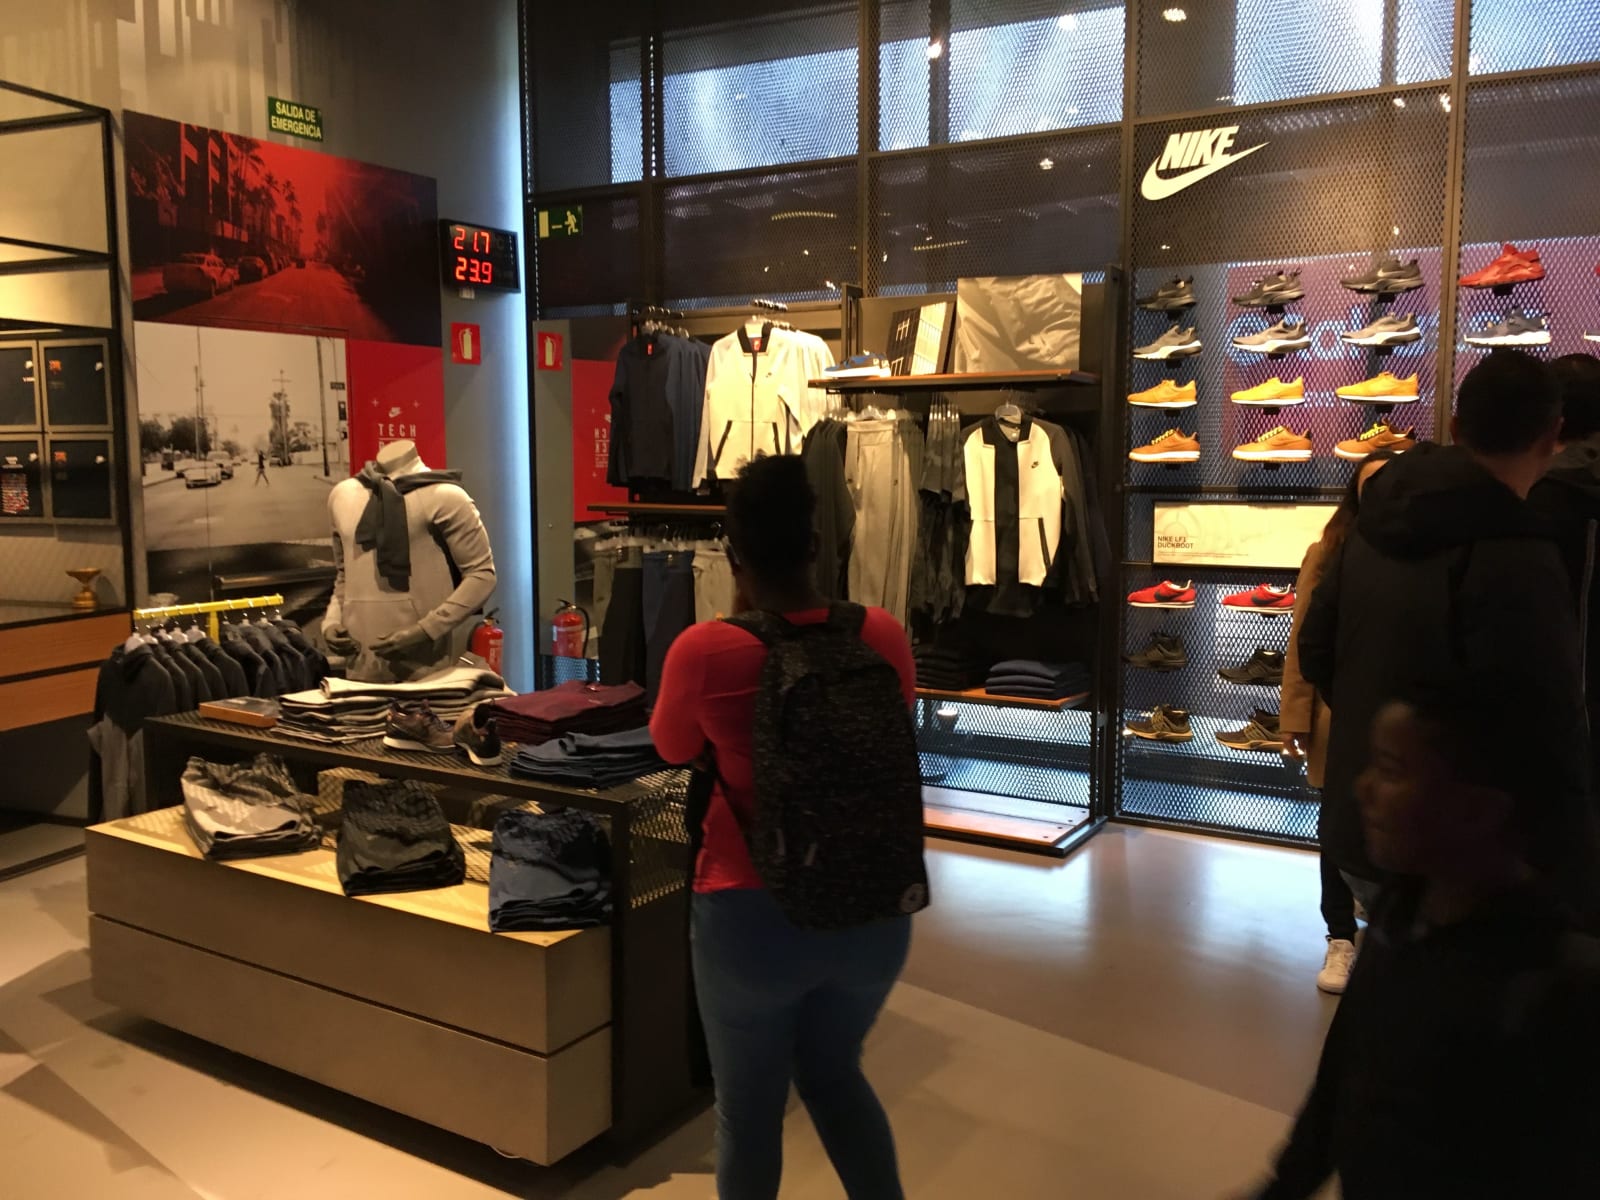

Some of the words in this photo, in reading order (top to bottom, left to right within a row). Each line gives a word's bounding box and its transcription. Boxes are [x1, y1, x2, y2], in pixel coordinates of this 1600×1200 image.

[275, 101, 304, 120] SALIDA
[304, 108, 316, 123] DE
[271, 115, 322, 139] EMERGENCIA
[1157, 125, 1240, 171] NIKE
[378, 423, 416, 437] TECH
[1157, 535, 1173, 543] NIKE
